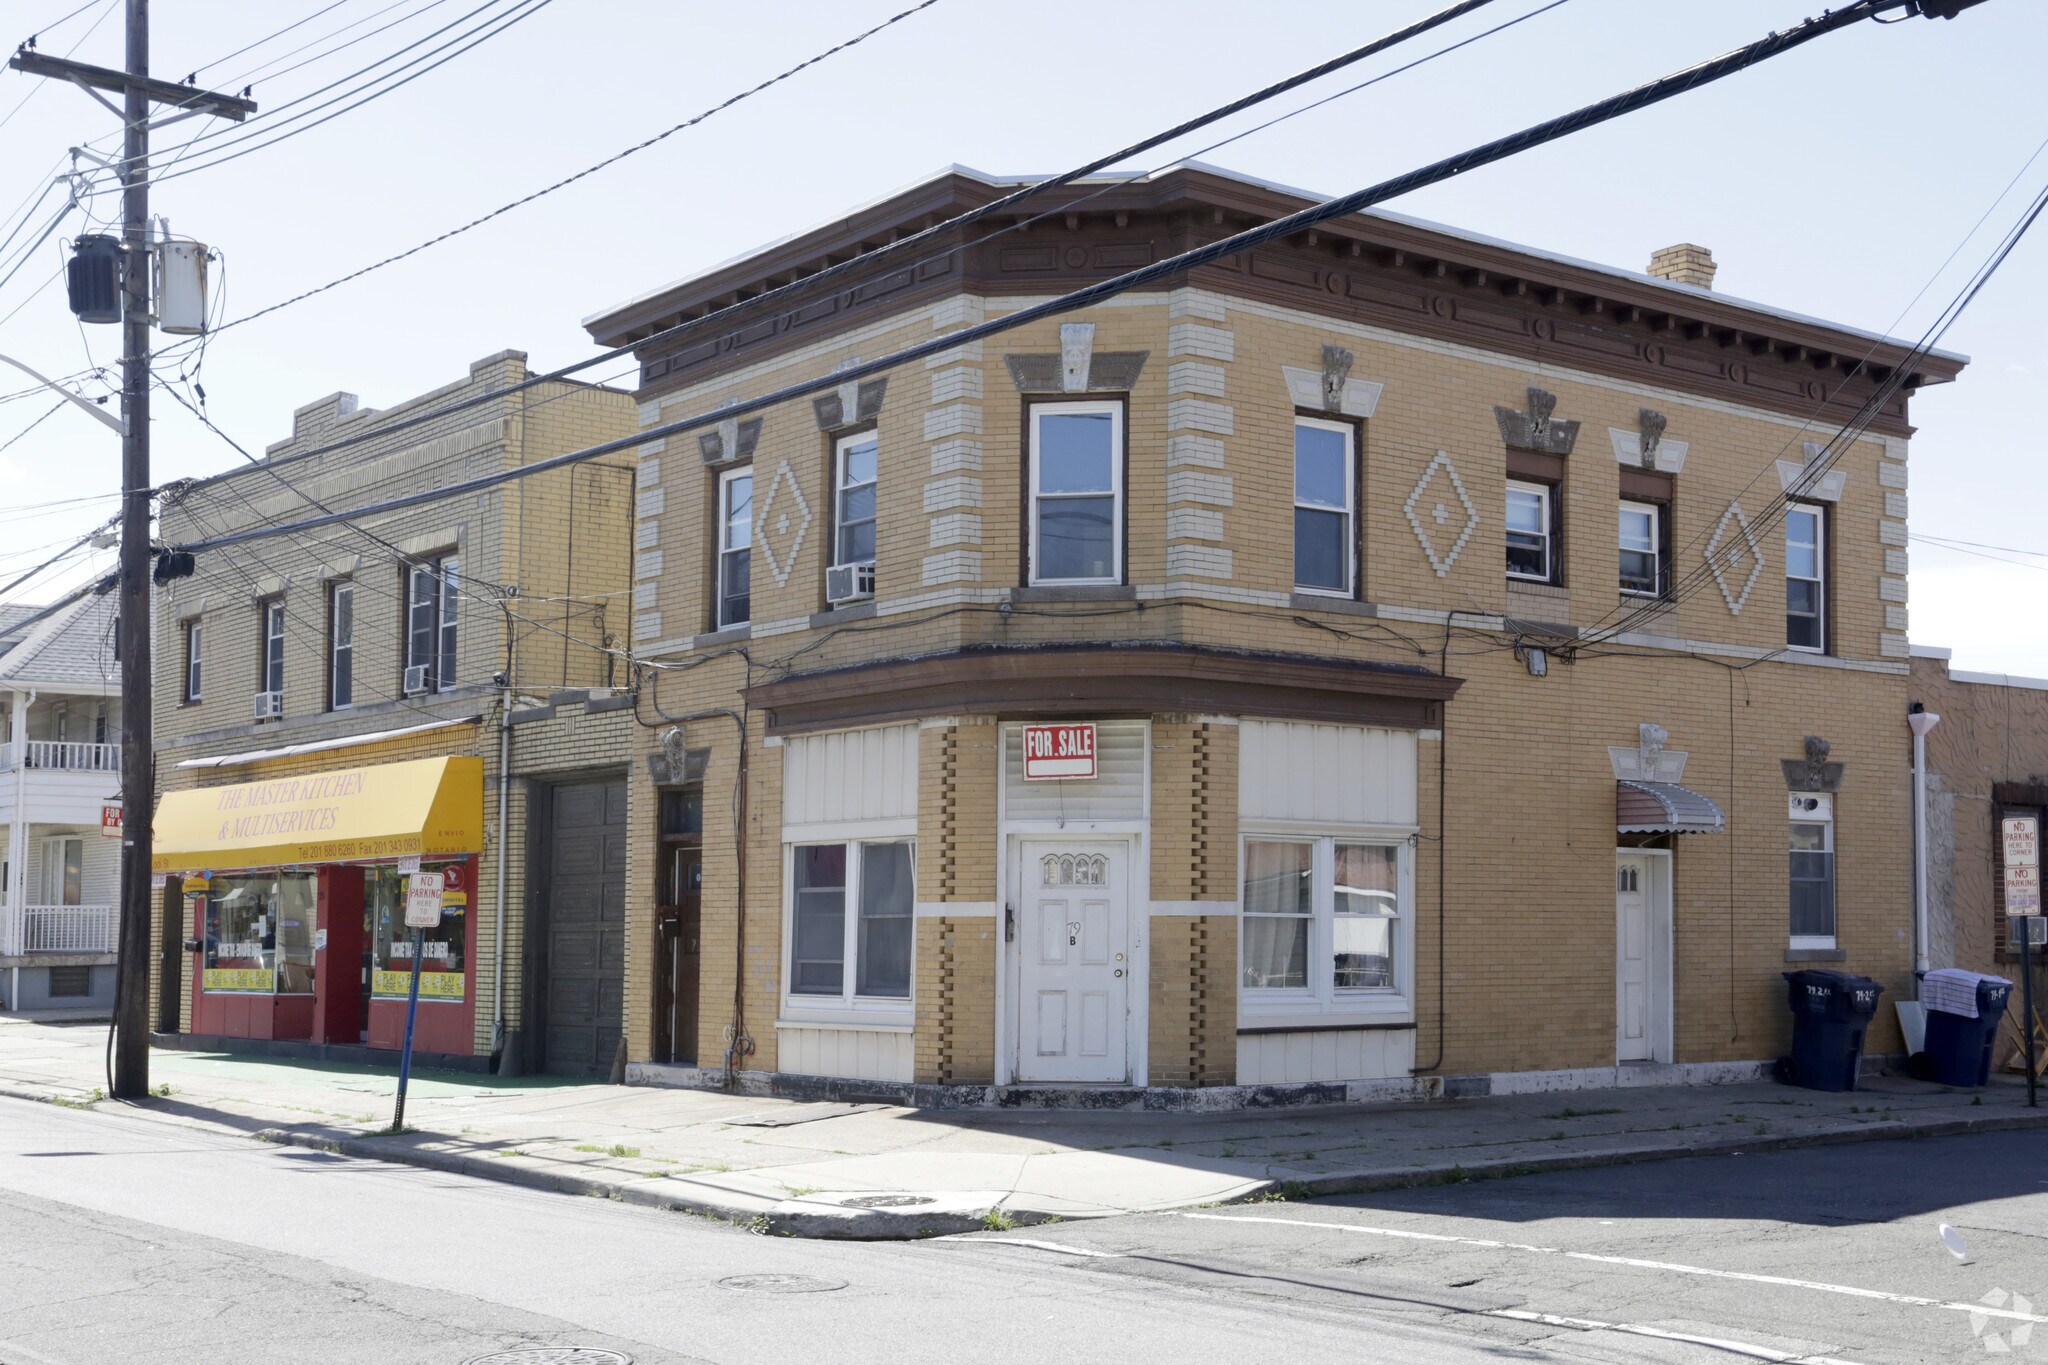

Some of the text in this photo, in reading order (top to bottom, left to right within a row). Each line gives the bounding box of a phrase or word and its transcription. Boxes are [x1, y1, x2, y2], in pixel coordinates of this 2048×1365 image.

[1028, 729, 1092, 757] FOR SALE
[217, 772, 368, 810] THE MASTER KITCHEN
[105, 807, 120, 818] FOR
[107, 817, 115, 826] BY
[218, 806, 339, 840] & MULTISERVICES
[2013, 822, 2025, 831] NO
[2006, 832, 2034, 842] PARKING
[299, 838, 421, 859] Tel 201 880 6260 Fax 201 343 0931
[2015, 870, 2028, 878] NO
[420, 876, 433, 886] NO
[410, 888, 440, 899] PARKING
[1066, 921, 1081, 936] 79
[1070, 936, 1076, 946] B
[384, 973, 396, 982] PLAY
[441, 974, 455, 983] PLAY
[384, 982, 396, 991] HERE
[441, 984, 454, 993] HERE
